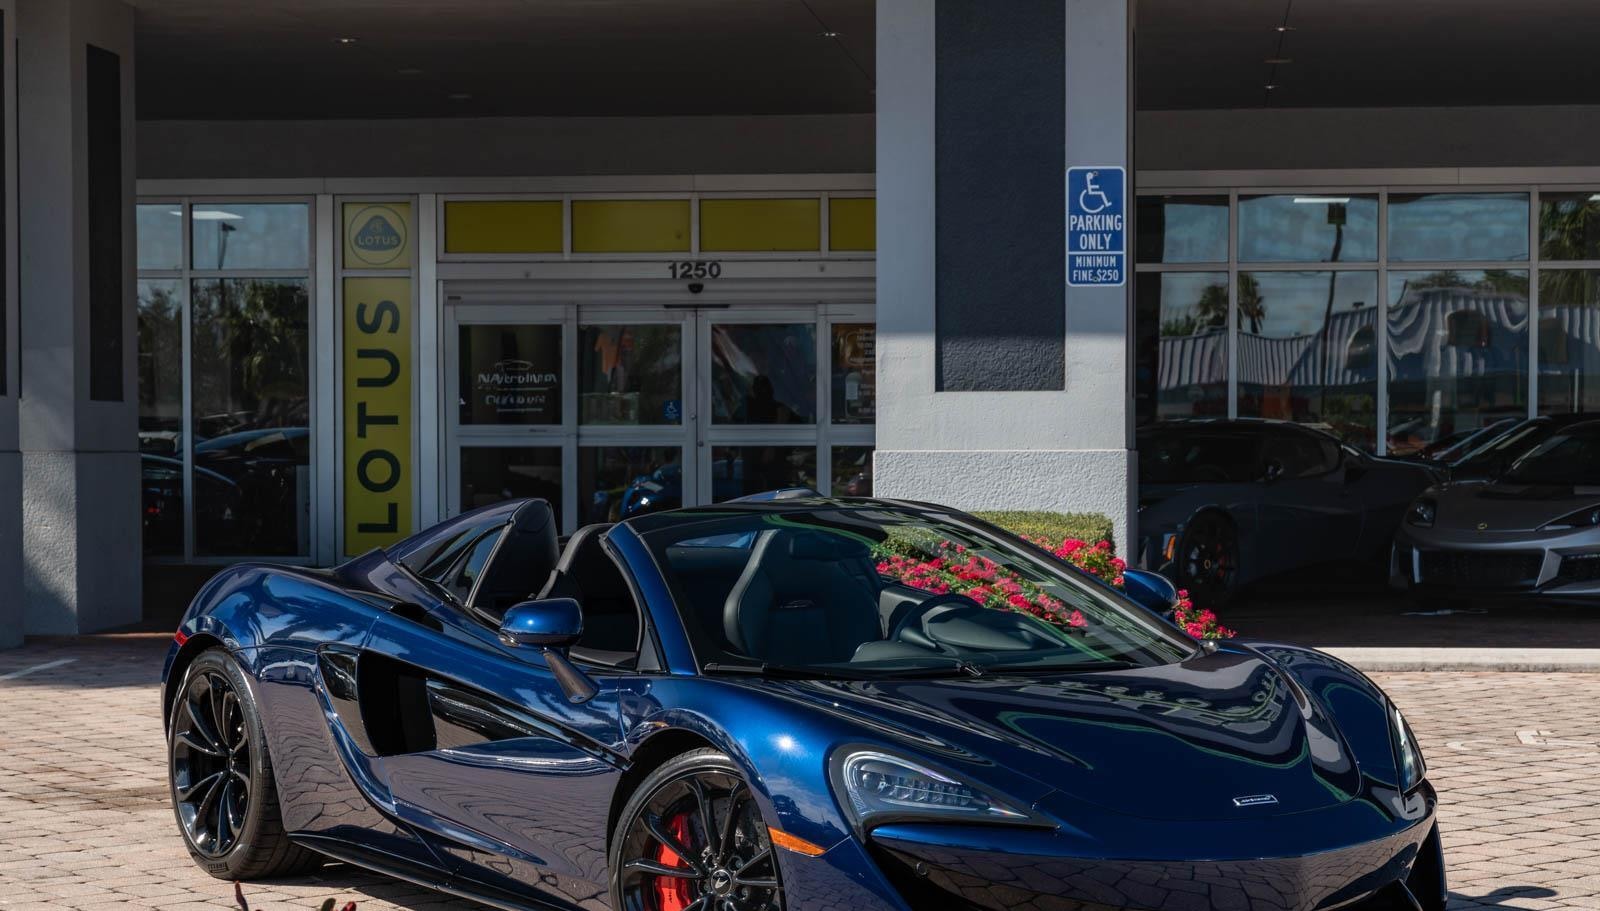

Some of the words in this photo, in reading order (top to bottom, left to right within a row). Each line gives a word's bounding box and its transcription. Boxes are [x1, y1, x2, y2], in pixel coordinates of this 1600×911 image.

[1069, 214, 1122, 231] PARKING
[358, 235, 398, 245] LOTUS
[1079, 233, 1112, 250] ONLY
[668, 261, 721, 279] 1250
[1075, 255, 1117, 268] MINIMUM
[1073, 269, 1093, 281] FINE
[1097, 268, 1119, 281] $250
[356, 300, 401, 533] LOTUS
